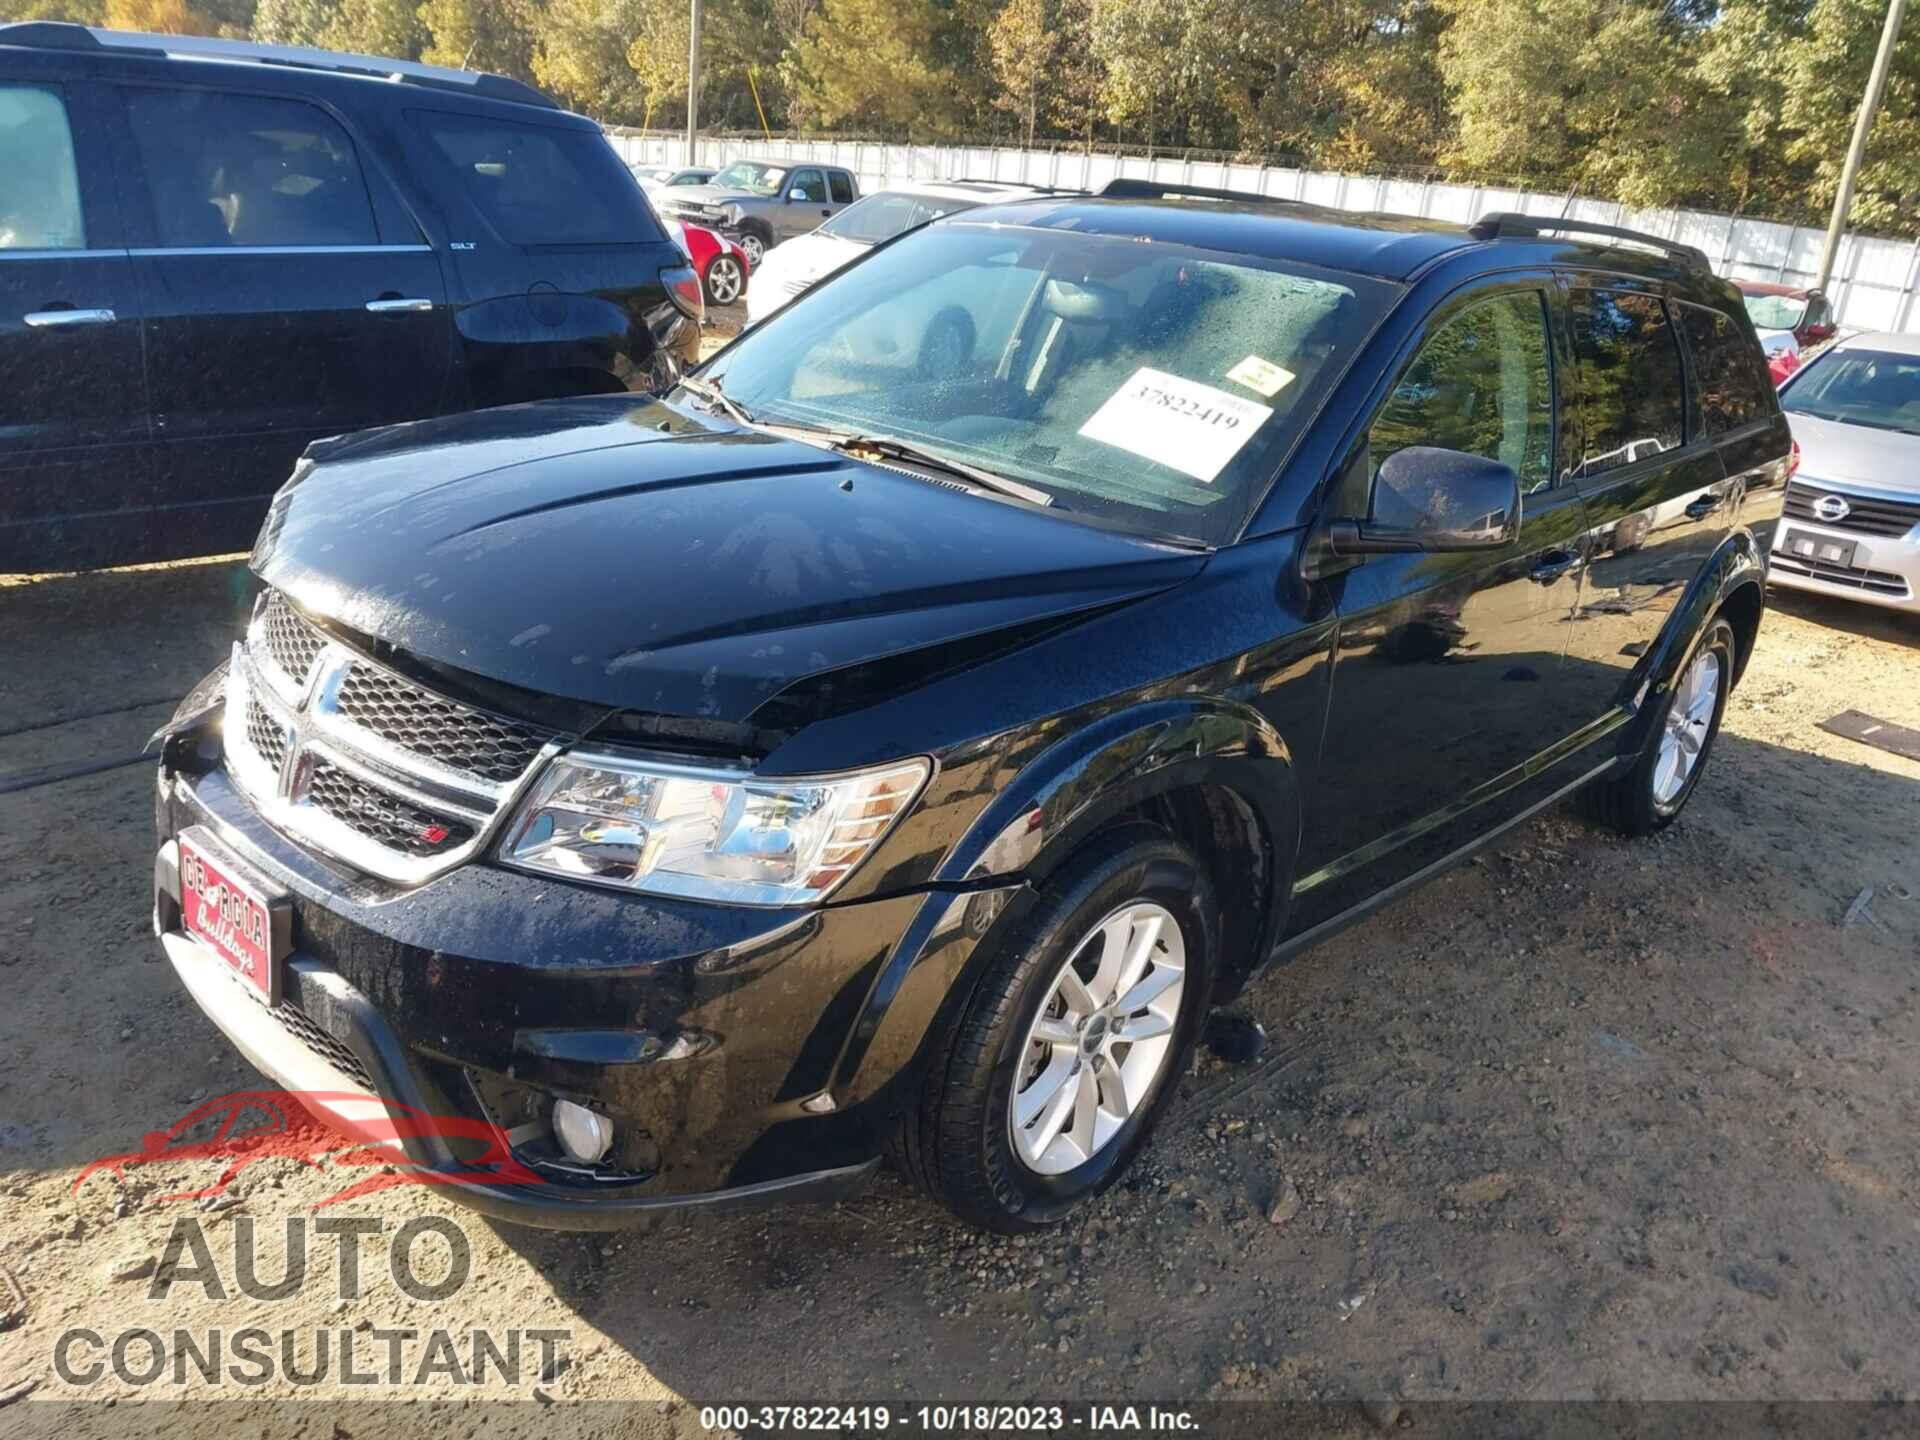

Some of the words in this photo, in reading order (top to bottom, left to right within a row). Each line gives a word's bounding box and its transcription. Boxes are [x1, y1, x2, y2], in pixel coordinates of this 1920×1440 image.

[449, 242, 476, 250] SLT
[1132, 386, 1240, 429] 37822419
[182, 853, 266, 952] GERGIA
[196, 904, 256, 974] Bulldogs
